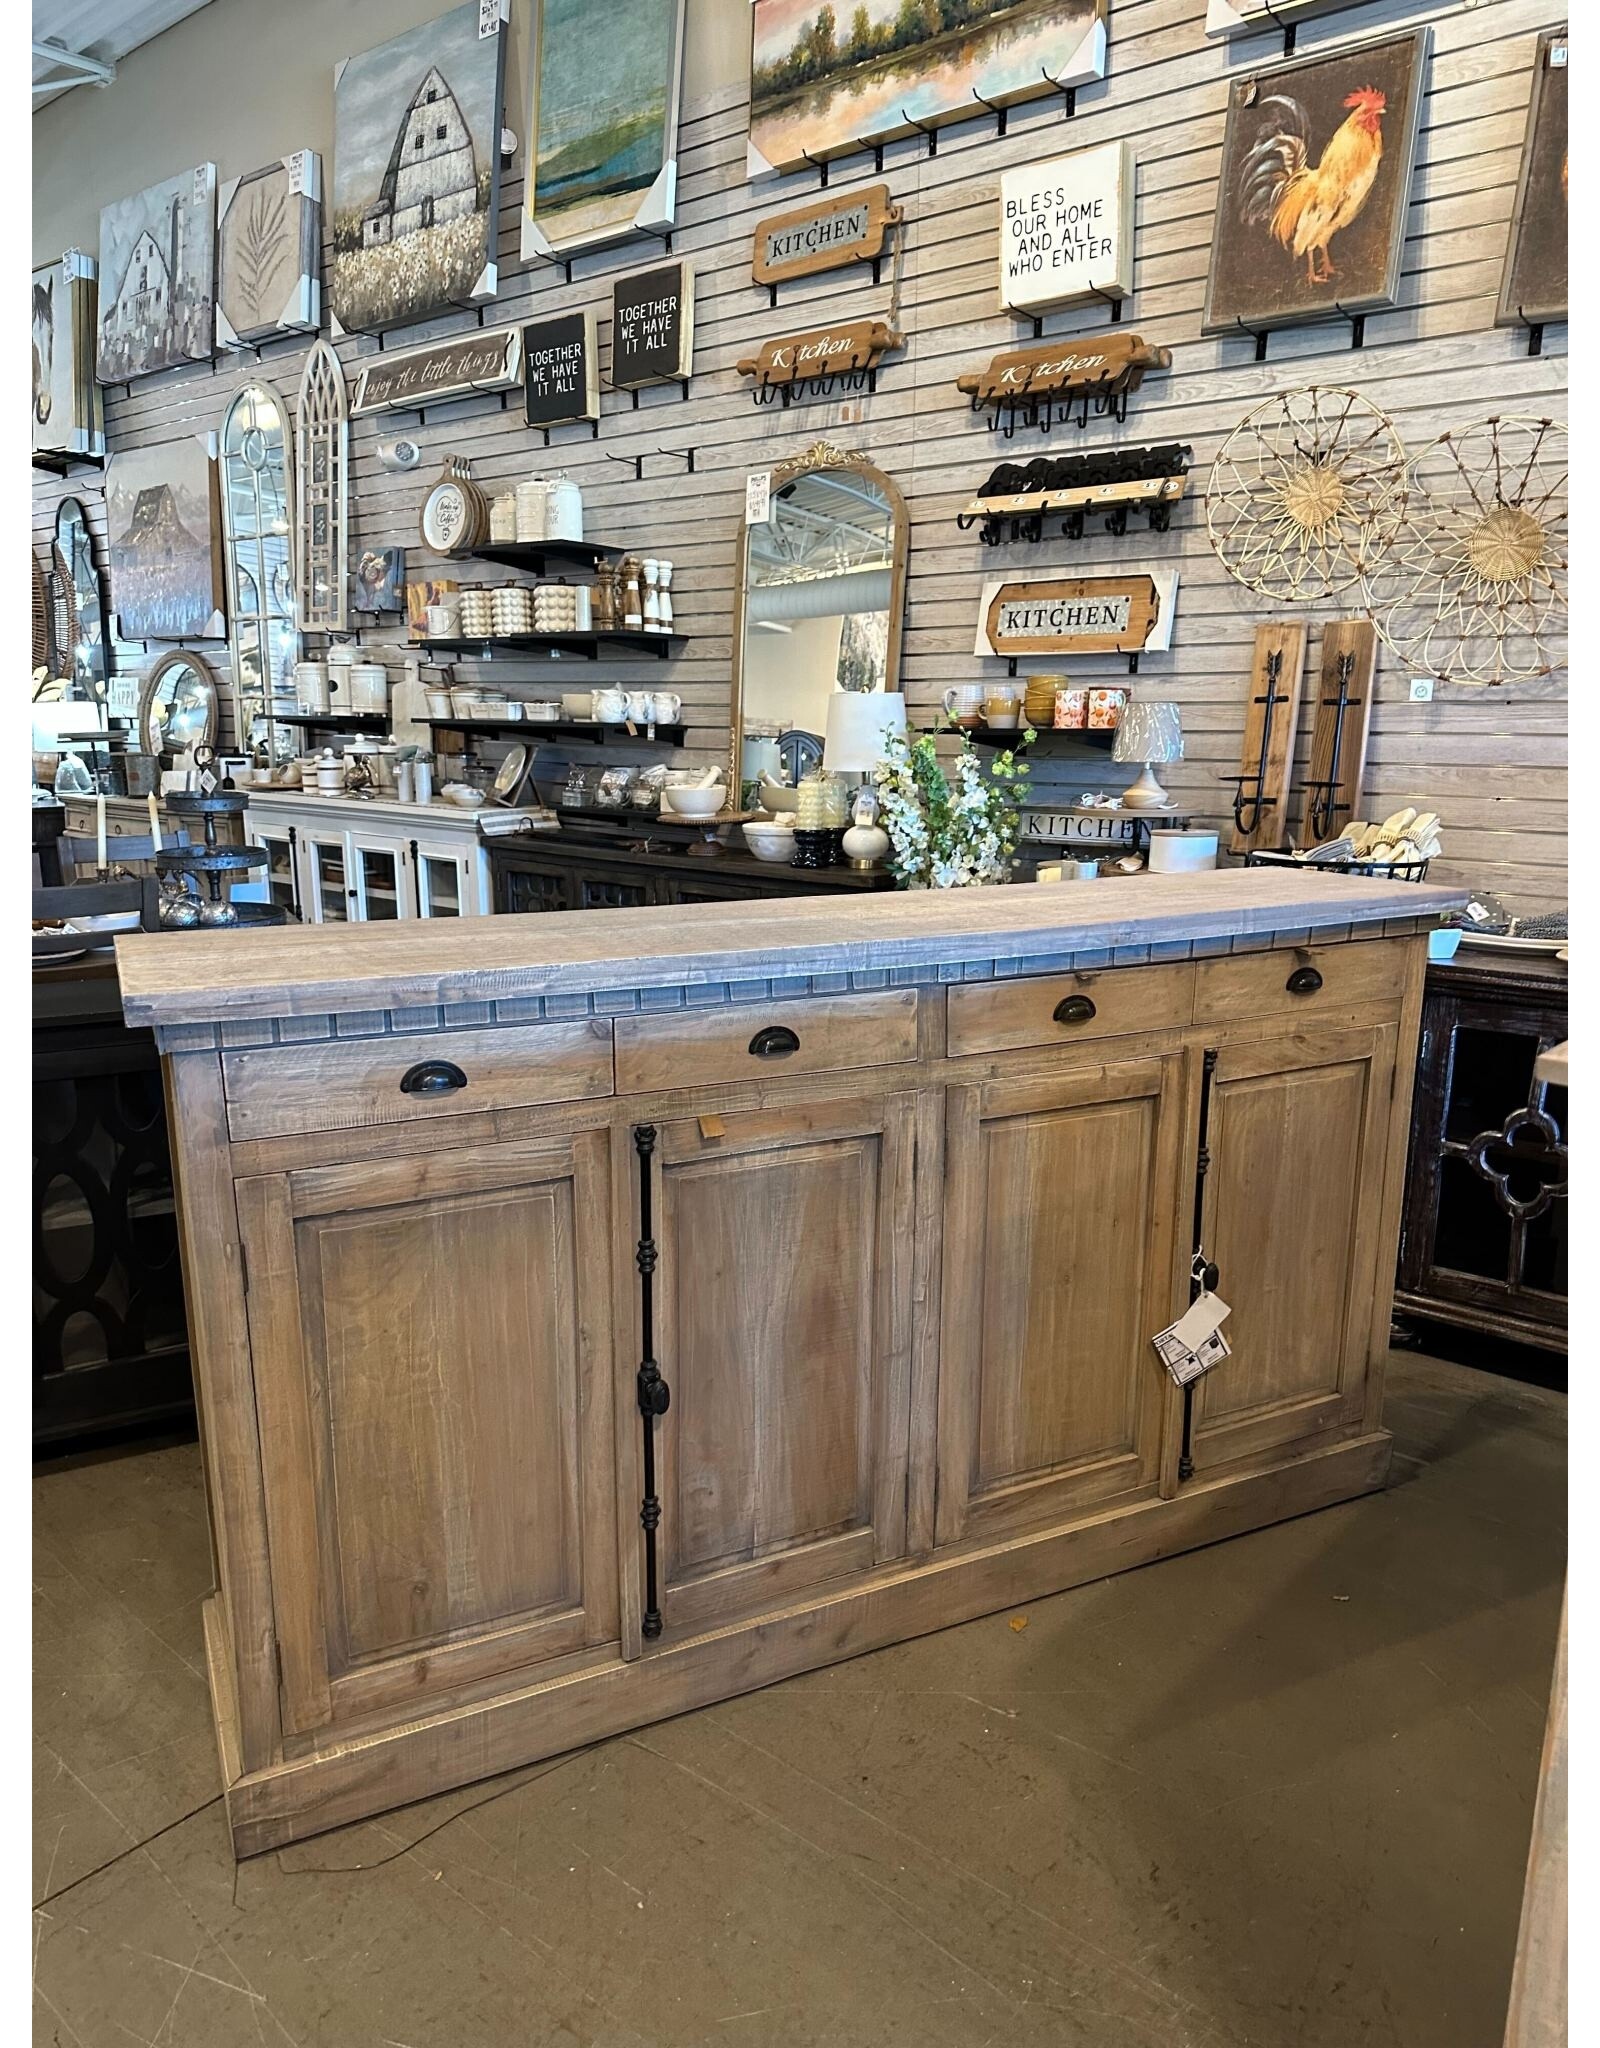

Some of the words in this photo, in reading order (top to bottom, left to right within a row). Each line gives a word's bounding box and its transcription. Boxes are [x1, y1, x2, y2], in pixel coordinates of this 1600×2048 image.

[1006, 187, 1066, 219] BLESS
[1012, 214, 1047, 238] OUR
[1056, 199, 1104, 228] HOME
[772, 215, 862, 258] KITCHEN
[1018, 232, 1053, 256] AND
[1061, 223, 1096, 246] ALL
[1008, 254, 1043, 278] WHO
[1052, 238, 1112, 268] ENTER
[618, 296, 678, 324] TOGETHER
[621, 324, 635, 341] WE
[642, 314, 673, 335] HAVE
[528, 343, 582, 367] TOGETHER
[626, 338, 639, 354] IT
[646, 333, 668, 350] ALL
[365, 377, 392, 400] enjoy
[396, 367, 417, 390] the
[421, 355, 453, 383] little
[457, 351, 499, 375] things
[532, 368, 545, 383] WE
[552, 360, 579, 380] HAVE
[538, 382, 549, 397] IT
[555, 378, 576, 394] ALL
[1006, 605, 1121, 629] KITCHEN
[1028, 815, 1154, 840] KITCHEN
